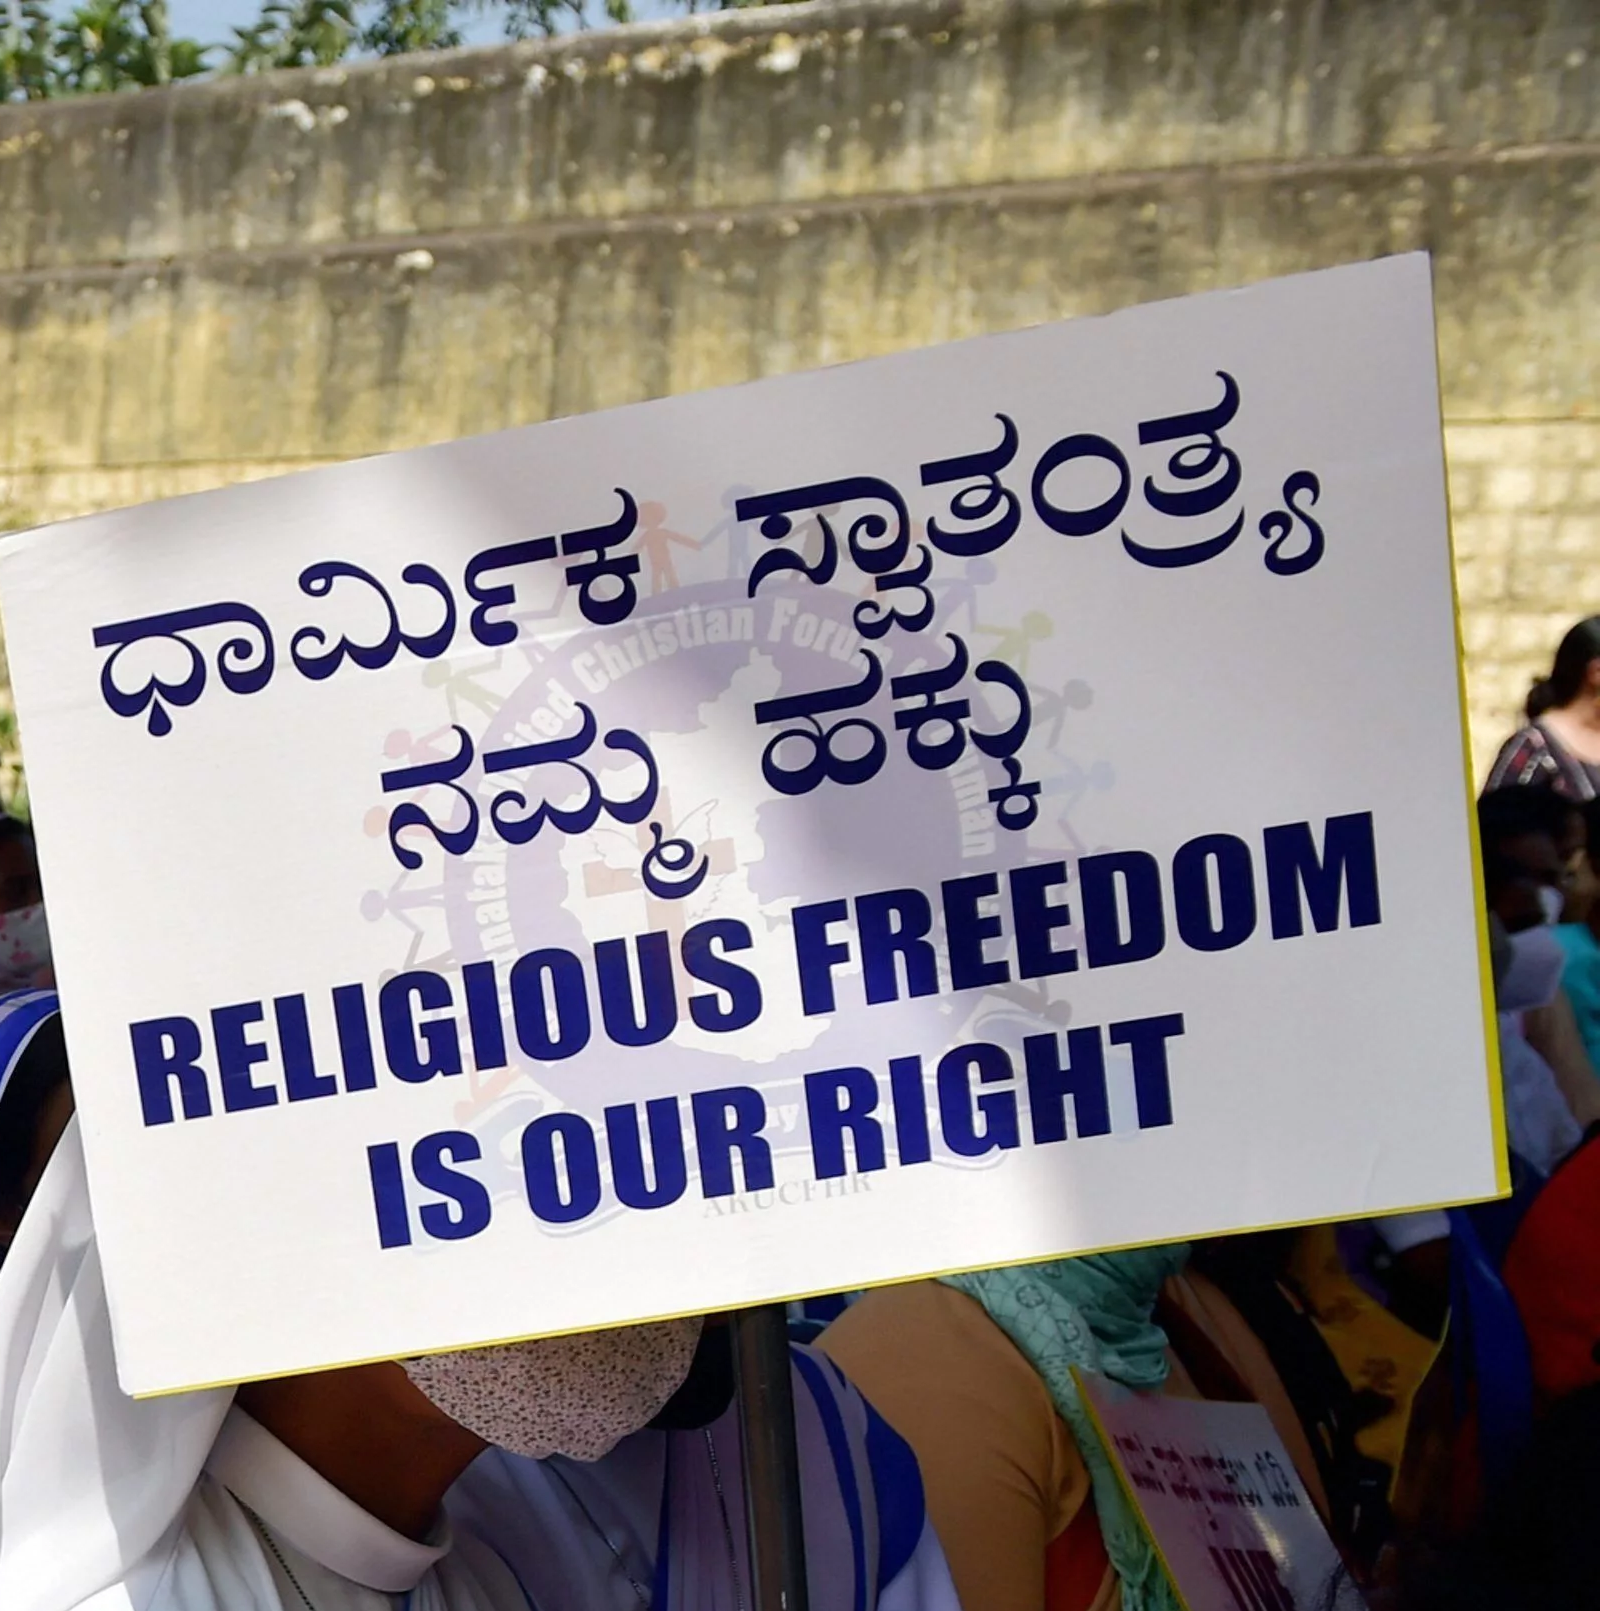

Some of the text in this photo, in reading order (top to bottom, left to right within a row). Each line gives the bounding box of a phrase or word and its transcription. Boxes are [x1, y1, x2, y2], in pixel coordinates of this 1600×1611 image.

[93, 371, 1325, 736] ಧಾರ್ಮಿಕ ಸ್ವಾತಂತ್ರ್ಯ
[572, 603, 755, 694] Christian
[381, 702, 708, 899] ನಮ್ಮ
[754, 633, 1041, 831] ಹಕ್ಕು
[130, 811, 1381, 1126] RELIGIOUS FREEDOM
[367, 1131, 491, 1249] IS
[521, 1087, 774, 1223] OUR
[804, 1013, 1185, 1180] RIGHT
